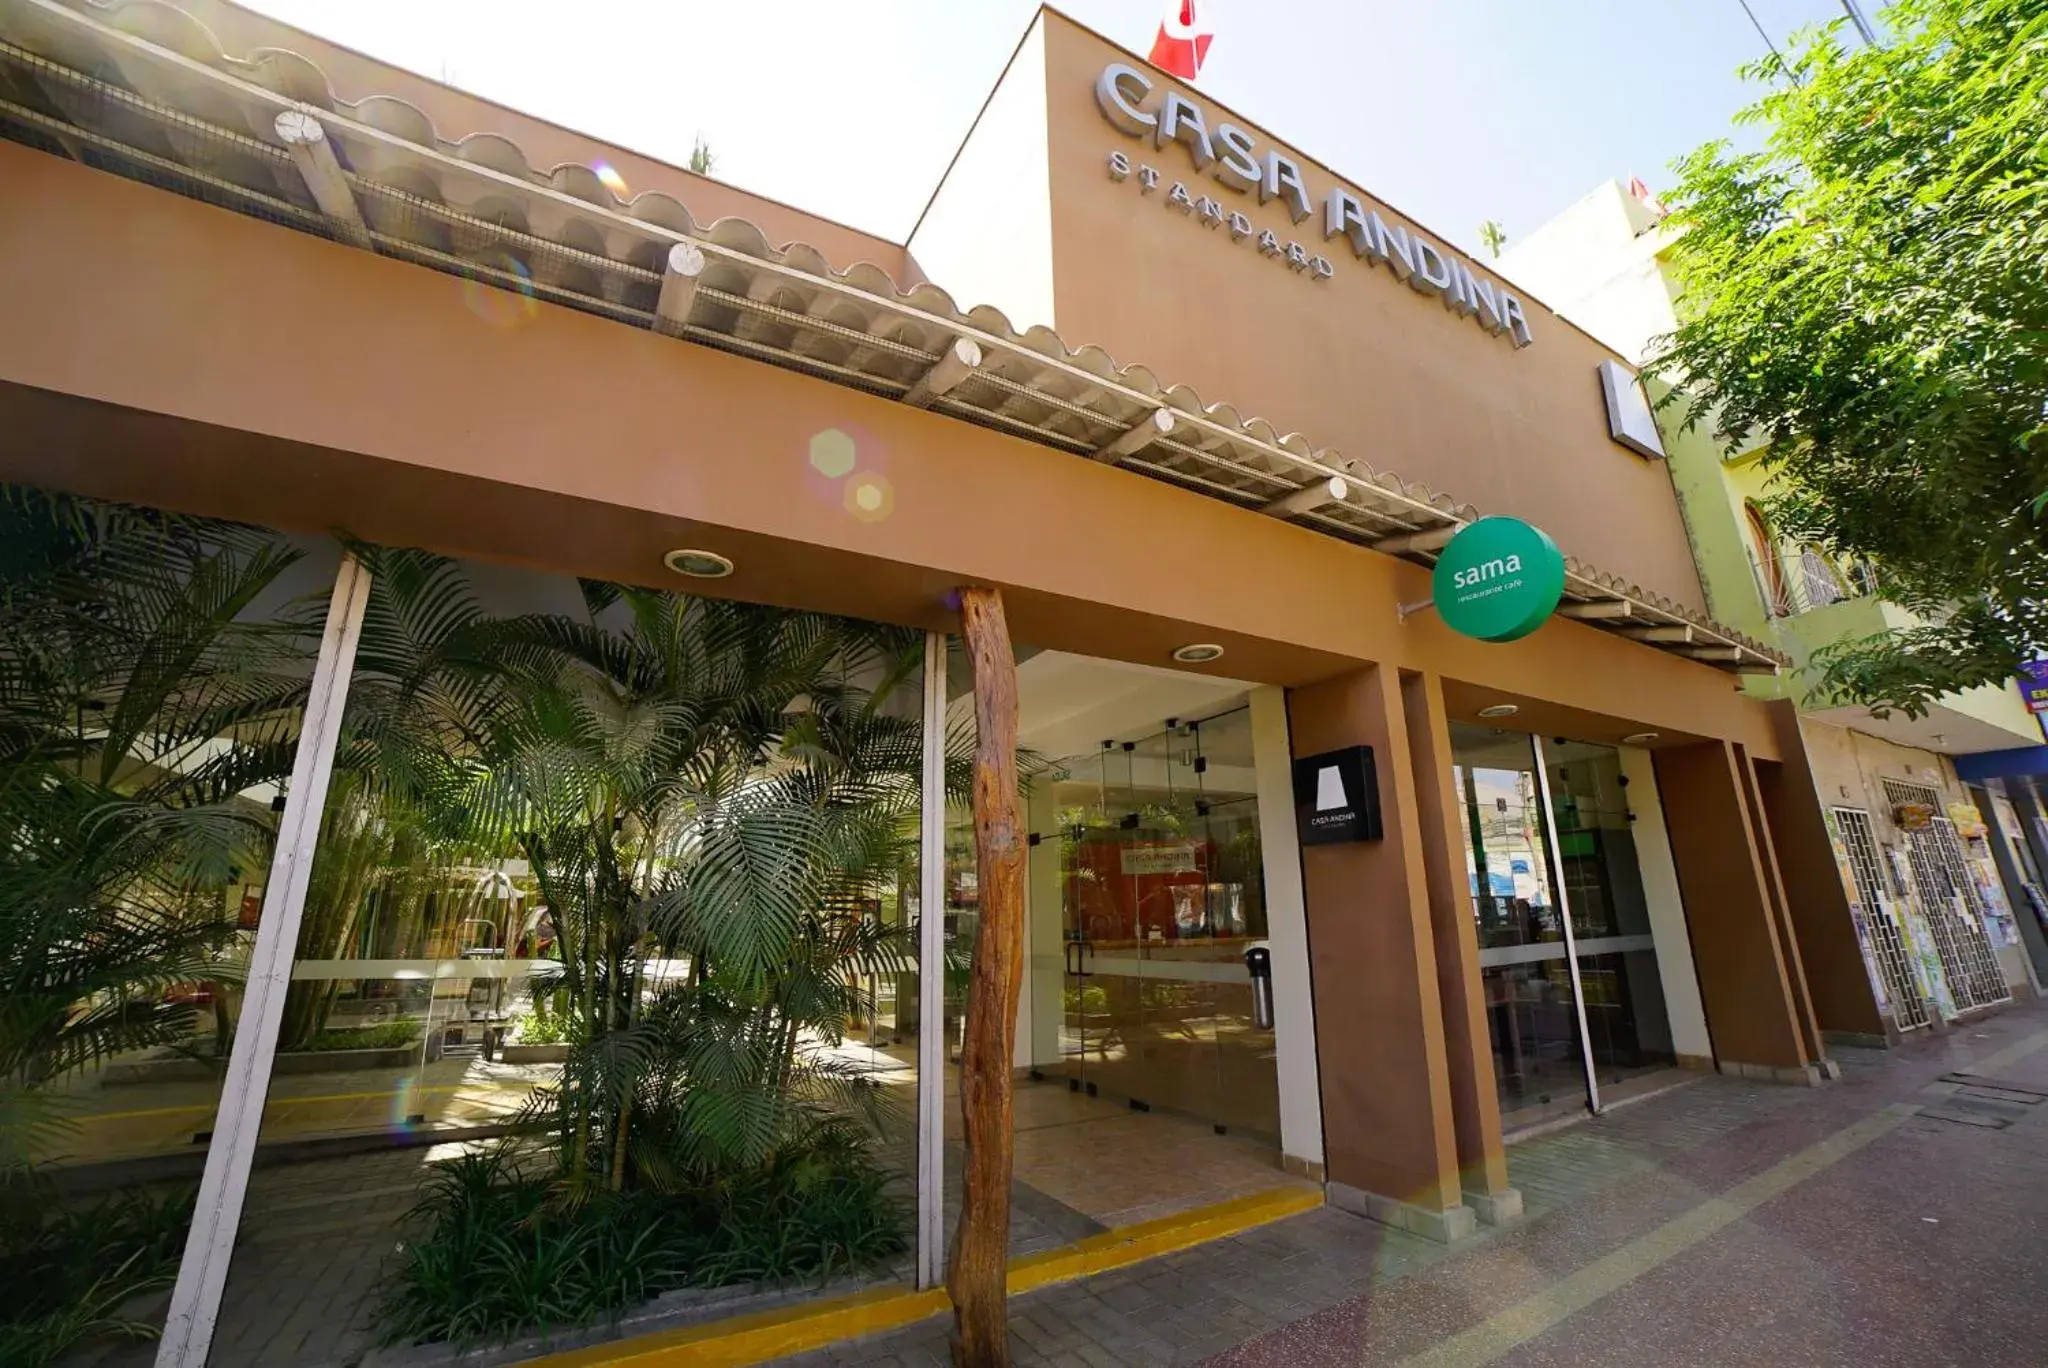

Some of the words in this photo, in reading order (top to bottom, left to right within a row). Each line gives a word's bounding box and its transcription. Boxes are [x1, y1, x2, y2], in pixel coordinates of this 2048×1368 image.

[1097, 63, 1313, 224] CASA
[1324, 187, 1533, 350] ANDINA
[1107, 150, 1335, 280] STANDARD
[1453, 554, 1522, 589] sama
[1311, 816, 1329, 826] CASA
